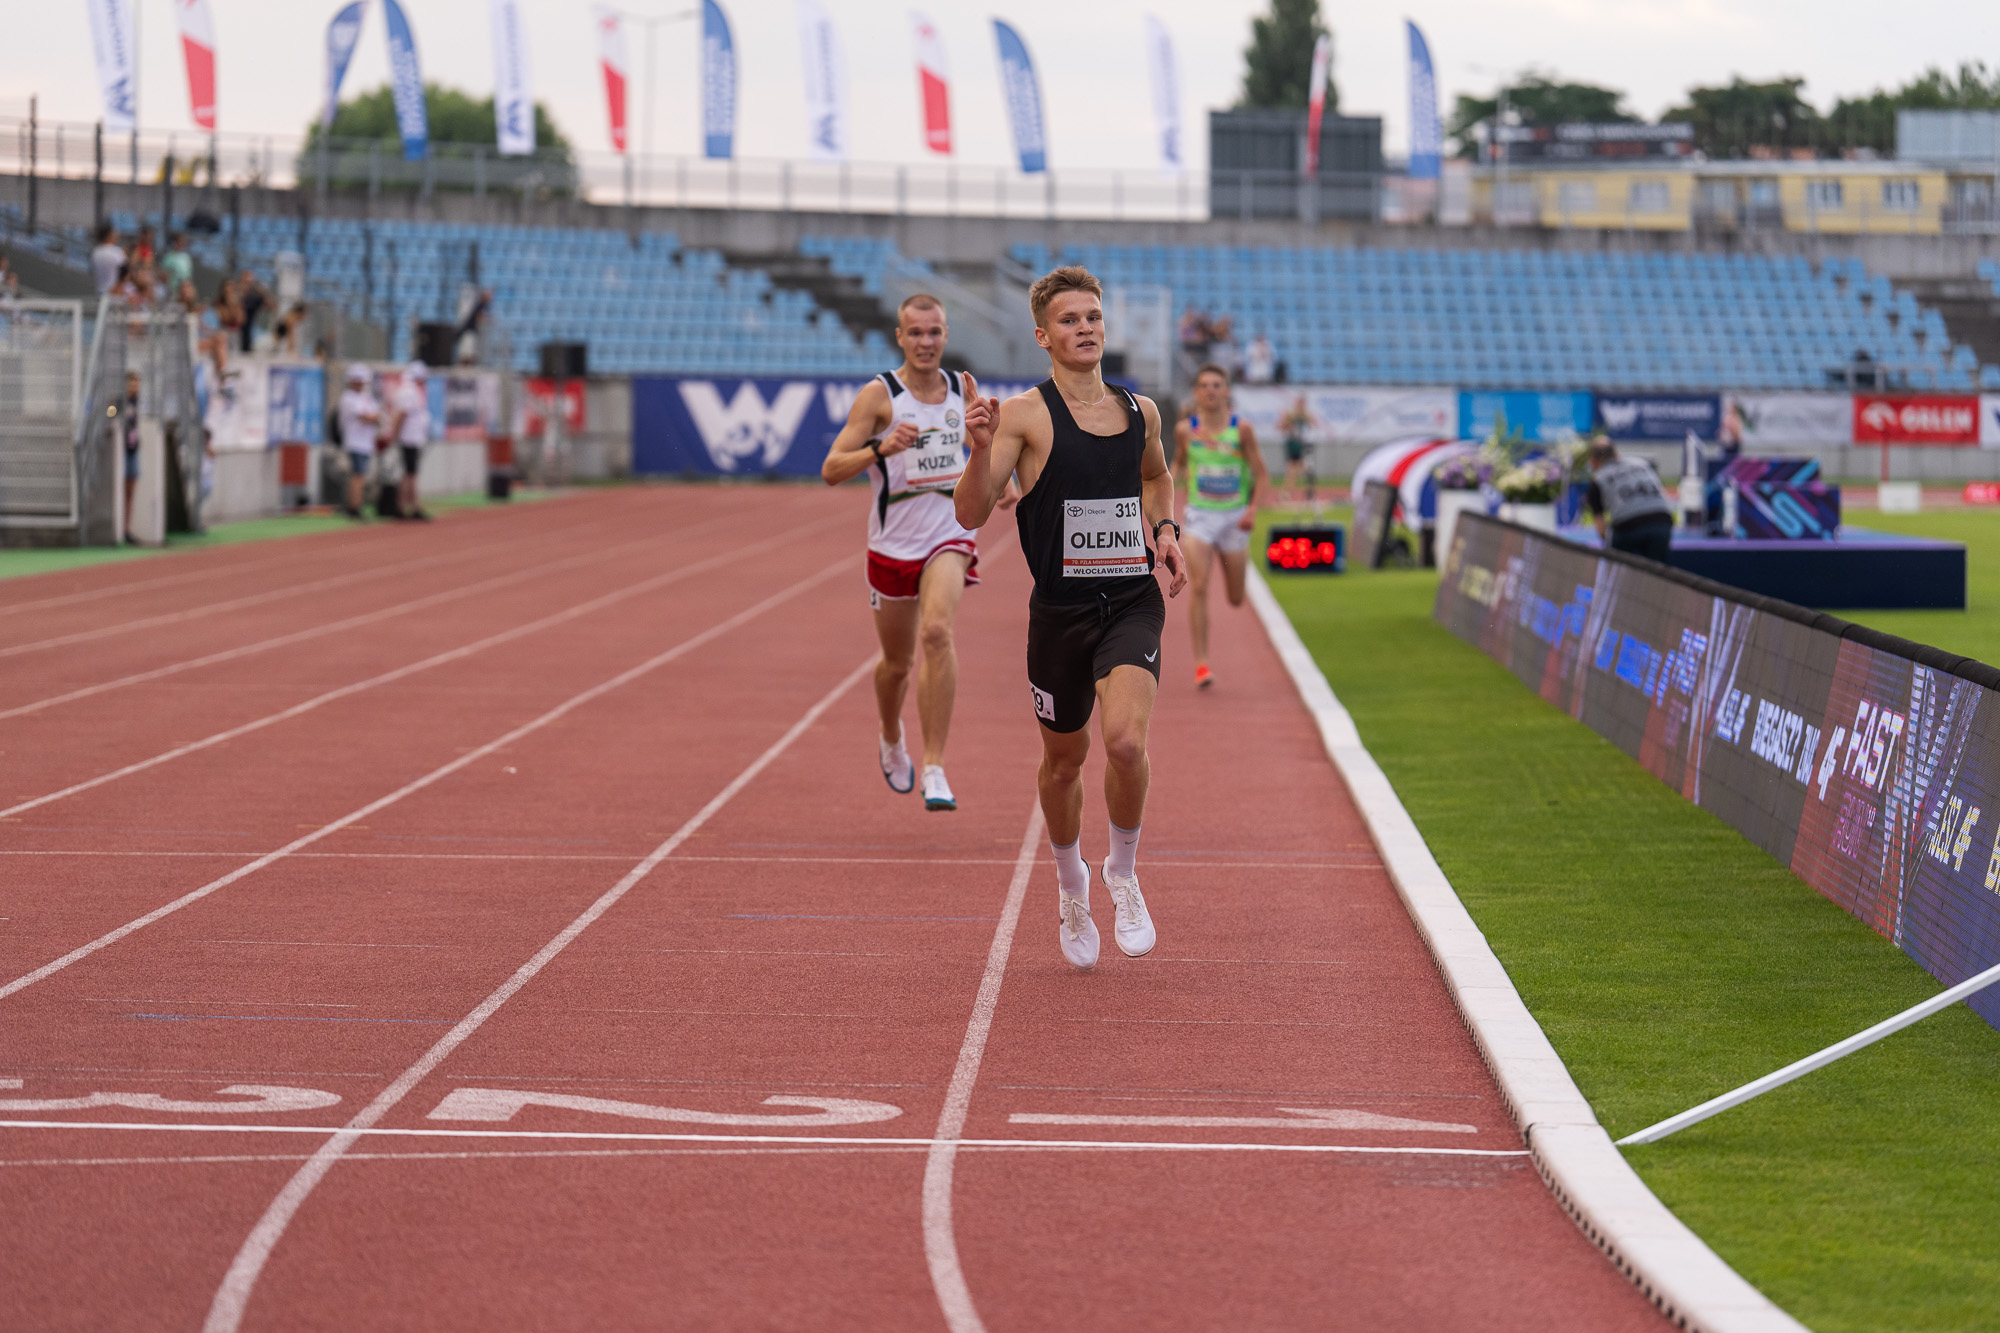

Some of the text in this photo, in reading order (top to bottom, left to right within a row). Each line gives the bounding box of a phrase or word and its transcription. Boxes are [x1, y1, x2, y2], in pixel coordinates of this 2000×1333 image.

[1900, 405, 1972, 434] ORLEN
[940, 432, 960, 445] 213
[918, 454, 957, 471] KUZIK
[1115, 502, 1137, 518] 313
[1070, 530, 1141, 549] OLEJNIK
[1073, 567, 1124, 575] WŁOCŁAWEK
[1750, 698, 1804, 774] BIEGASZ?
[1842, 699, 1904, 794] FAST
